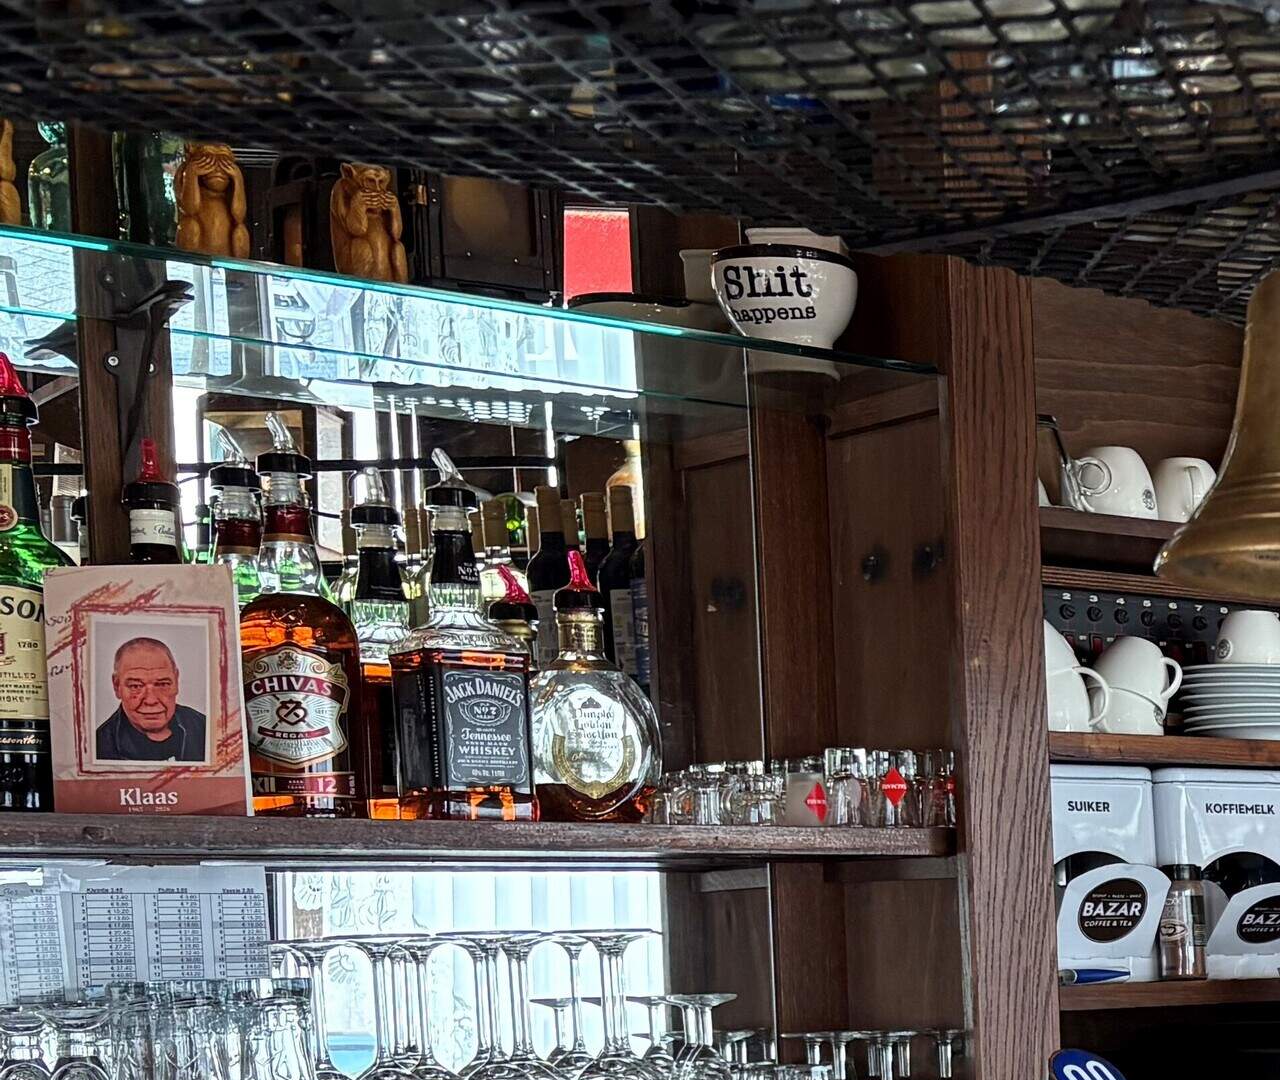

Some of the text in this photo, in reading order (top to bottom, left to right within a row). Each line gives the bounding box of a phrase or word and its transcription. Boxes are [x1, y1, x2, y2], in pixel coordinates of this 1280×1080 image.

[723, 265, 813, 301] Shit
[731, 305, 817, 325] happens
[250, 676, 333, 697] CHIVAS
[446, 678, 525, 707] JACK DANIEL'S
[462, 728, 513, 742] Tennessee
[459, 746, 517, 757] WHISKEY
[316, 776, 338, 793] 12
[119, 787, 179, 806] Klaas
[1067, 799, 1111, 814] SUIKER
[1204, 802, 1276, 816] KOFFIEMELK
[1081, 901, 1144, 918] BAZAR
[1083, 920, 1113, 929] COFFEE
[1119, 919, 1134, 928] TEA
[1242, 926, 1267, 934] COFFEE
